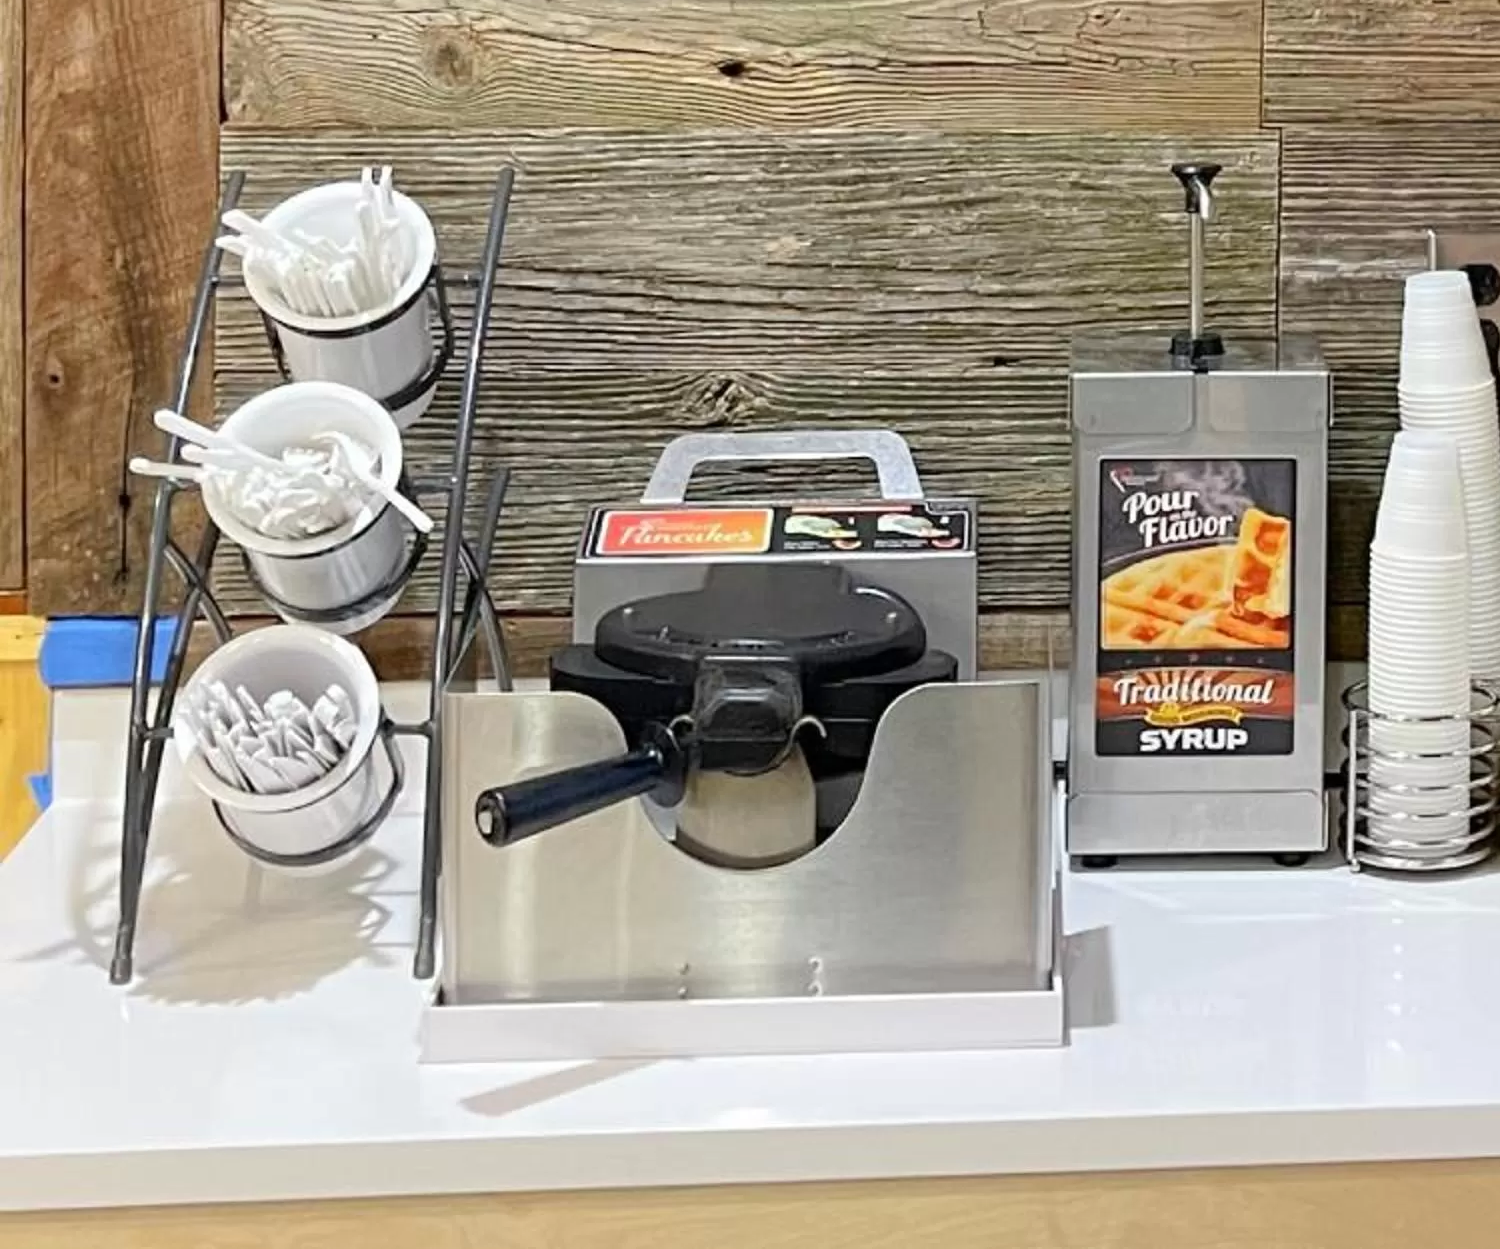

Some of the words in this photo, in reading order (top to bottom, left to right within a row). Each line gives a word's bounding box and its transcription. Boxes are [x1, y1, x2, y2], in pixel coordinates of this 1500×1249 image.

[1122, 491, 1199, 523] Pour
[1139, 515, 1234, 548] Flavor
[1113, 677, 1275, 706] Traditional
[1140, 728, 1248, 752] SYRUP
